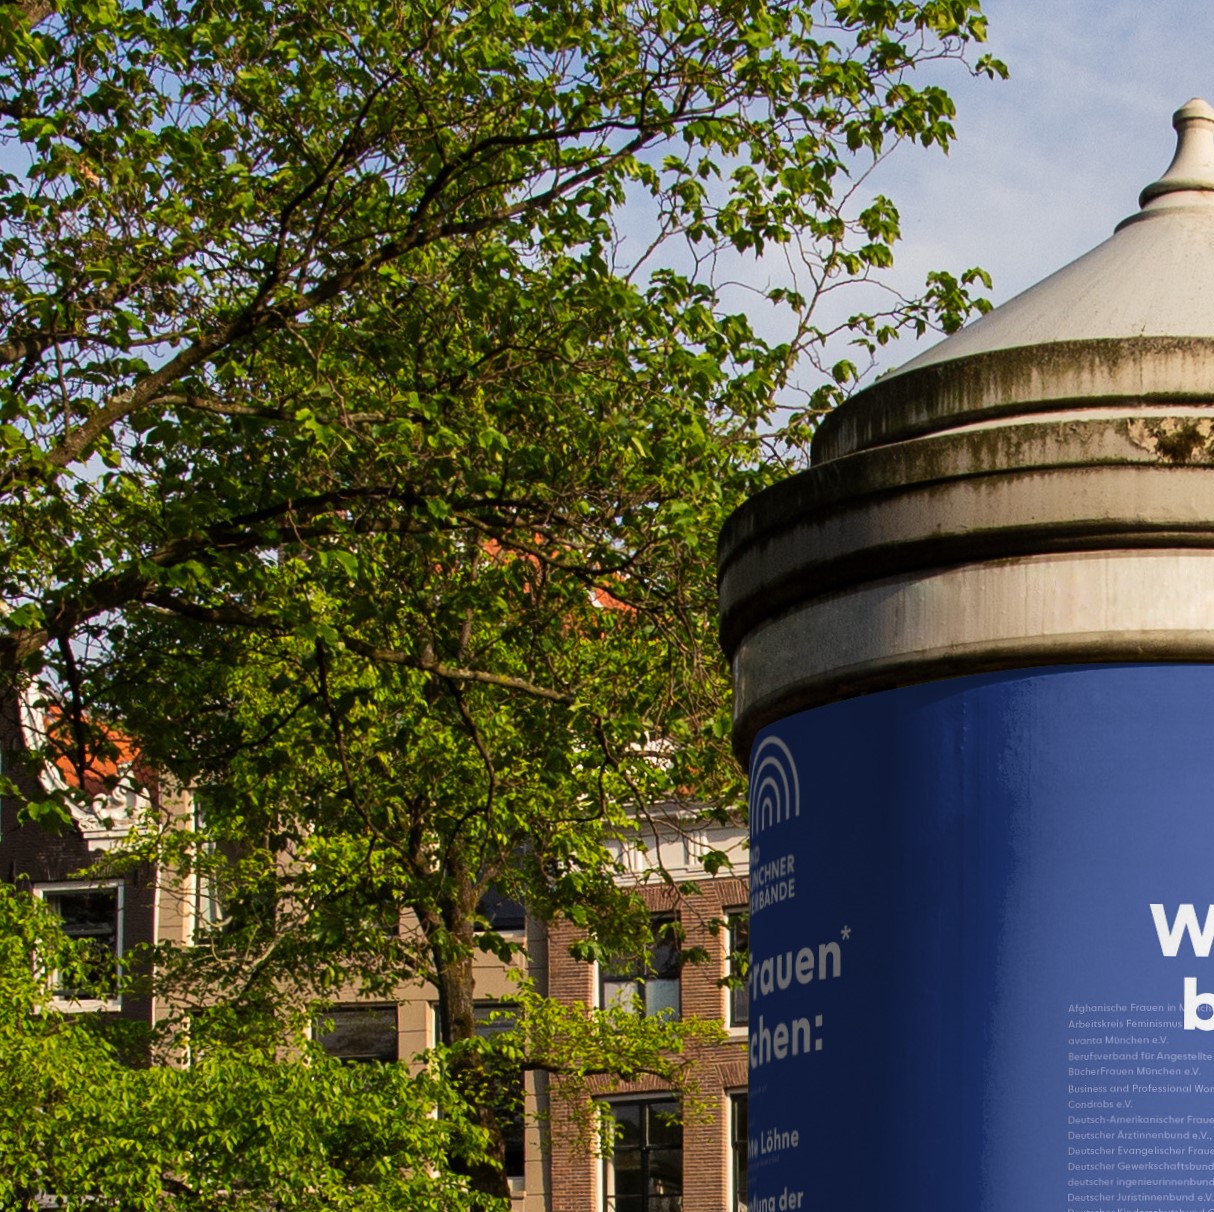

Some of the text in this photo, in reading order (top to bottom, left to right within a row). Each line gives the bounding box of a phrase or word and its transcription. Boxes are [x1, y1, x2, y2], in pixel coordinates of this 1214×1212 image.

[1106, 1036, 1149, 1044] München
[1069, 1051, 1138, 1061] Berufsverband
[1141, 1052, 1155, 1060] für
[1157, 1052, 1212, 1062] Angestellte
[1069, 1067, 1200, 1076] BücherFrauen München e.V.
[1069, 1085, 1107, 1093] Business
[1110, 1084, 1129, 1092] and
[1133, 1084, 1191, 1092] Professional
[1068, 1100, 1133, 1108] Condrobs e.V.
[761, 1128, 799, 1154] Löhne
[779, 1187, 803, 1211] der
